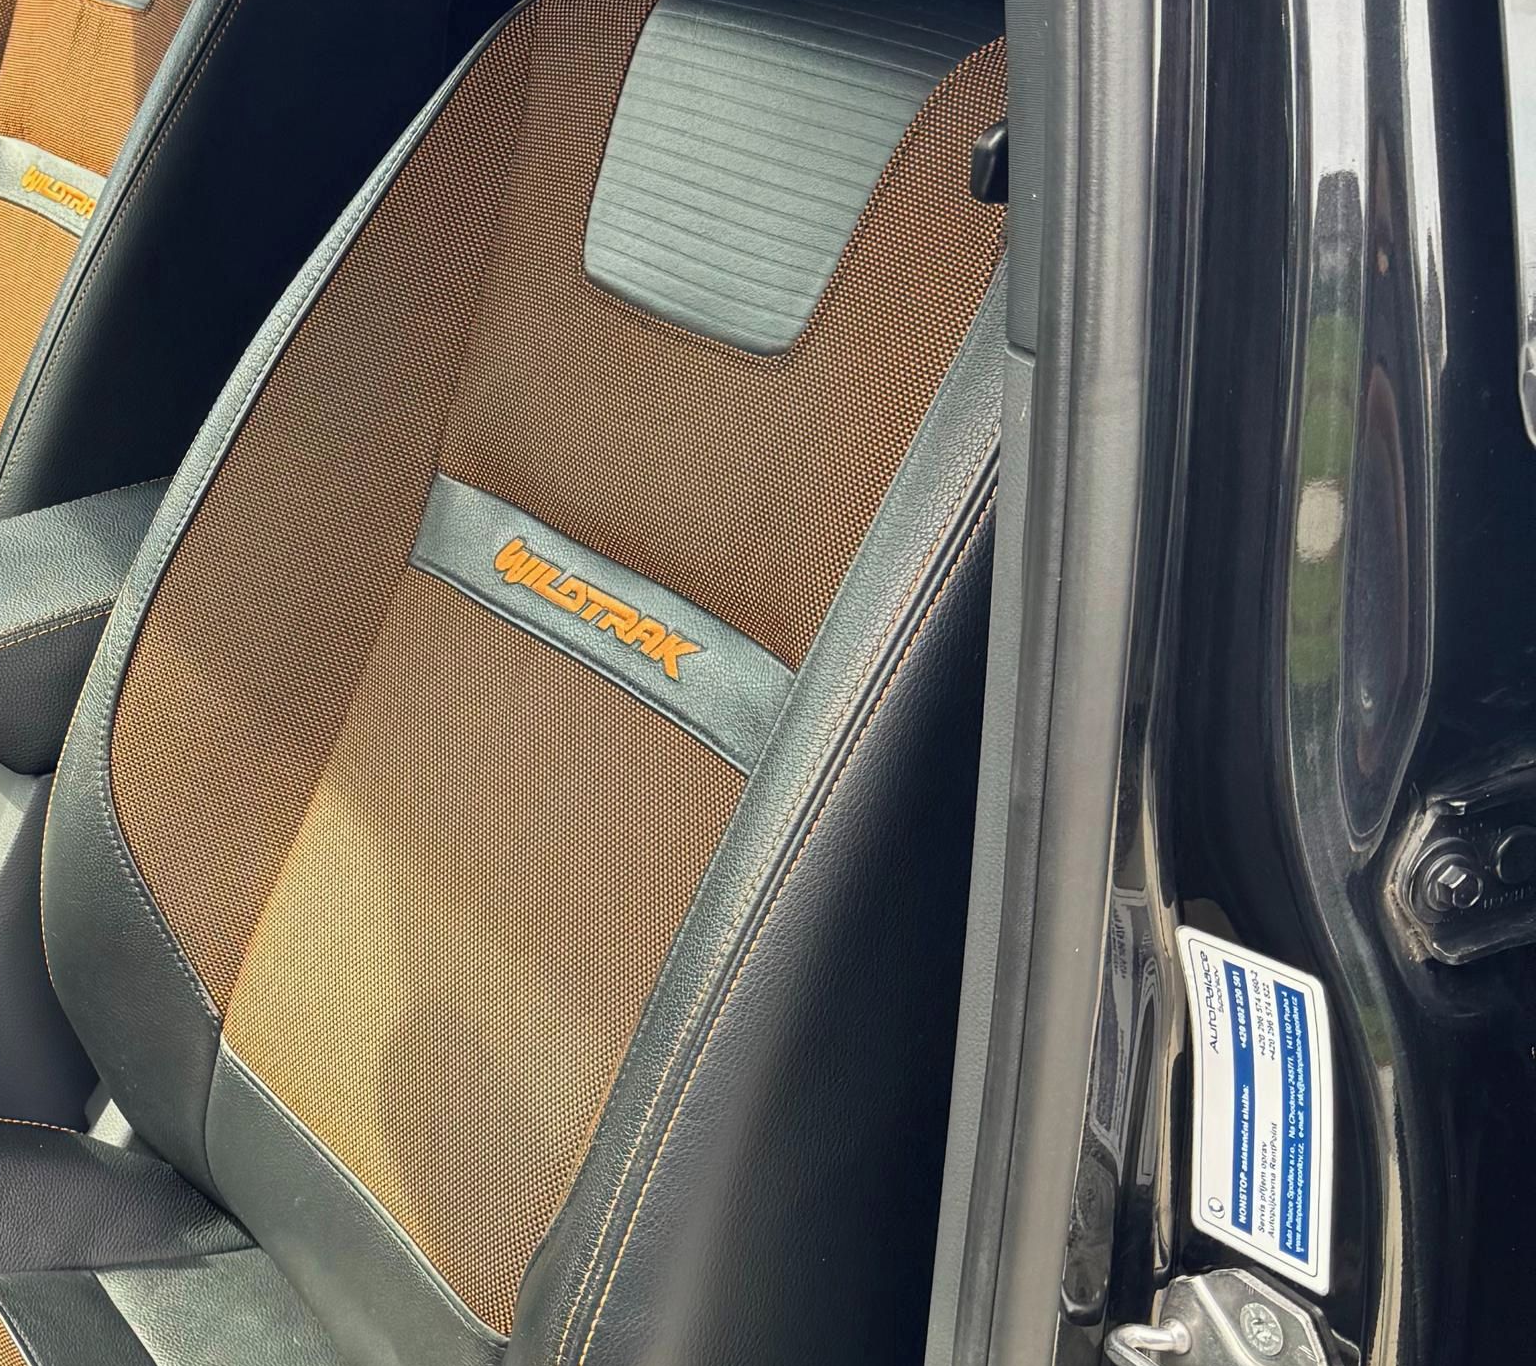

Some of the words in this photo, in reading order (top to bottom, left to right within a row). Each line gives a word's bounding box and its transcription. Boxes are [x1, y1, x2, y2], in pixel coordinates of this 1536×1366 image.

[21, 165, 97, 220] WILDTRA
[494, 537, 702, 681] WILDTRAK
[1199, 950, 1219, 1054] AutoPalace
[1269, 1122, 1278, 1169] RentPoint
[1238, 1173, 1248, 1223] NONSTOP
[1257, 1204, 1265, 1233] Servis
[1285, 1201, 1294, 1228] Palace
[1285, 1229, 1293, 1249] Auto
